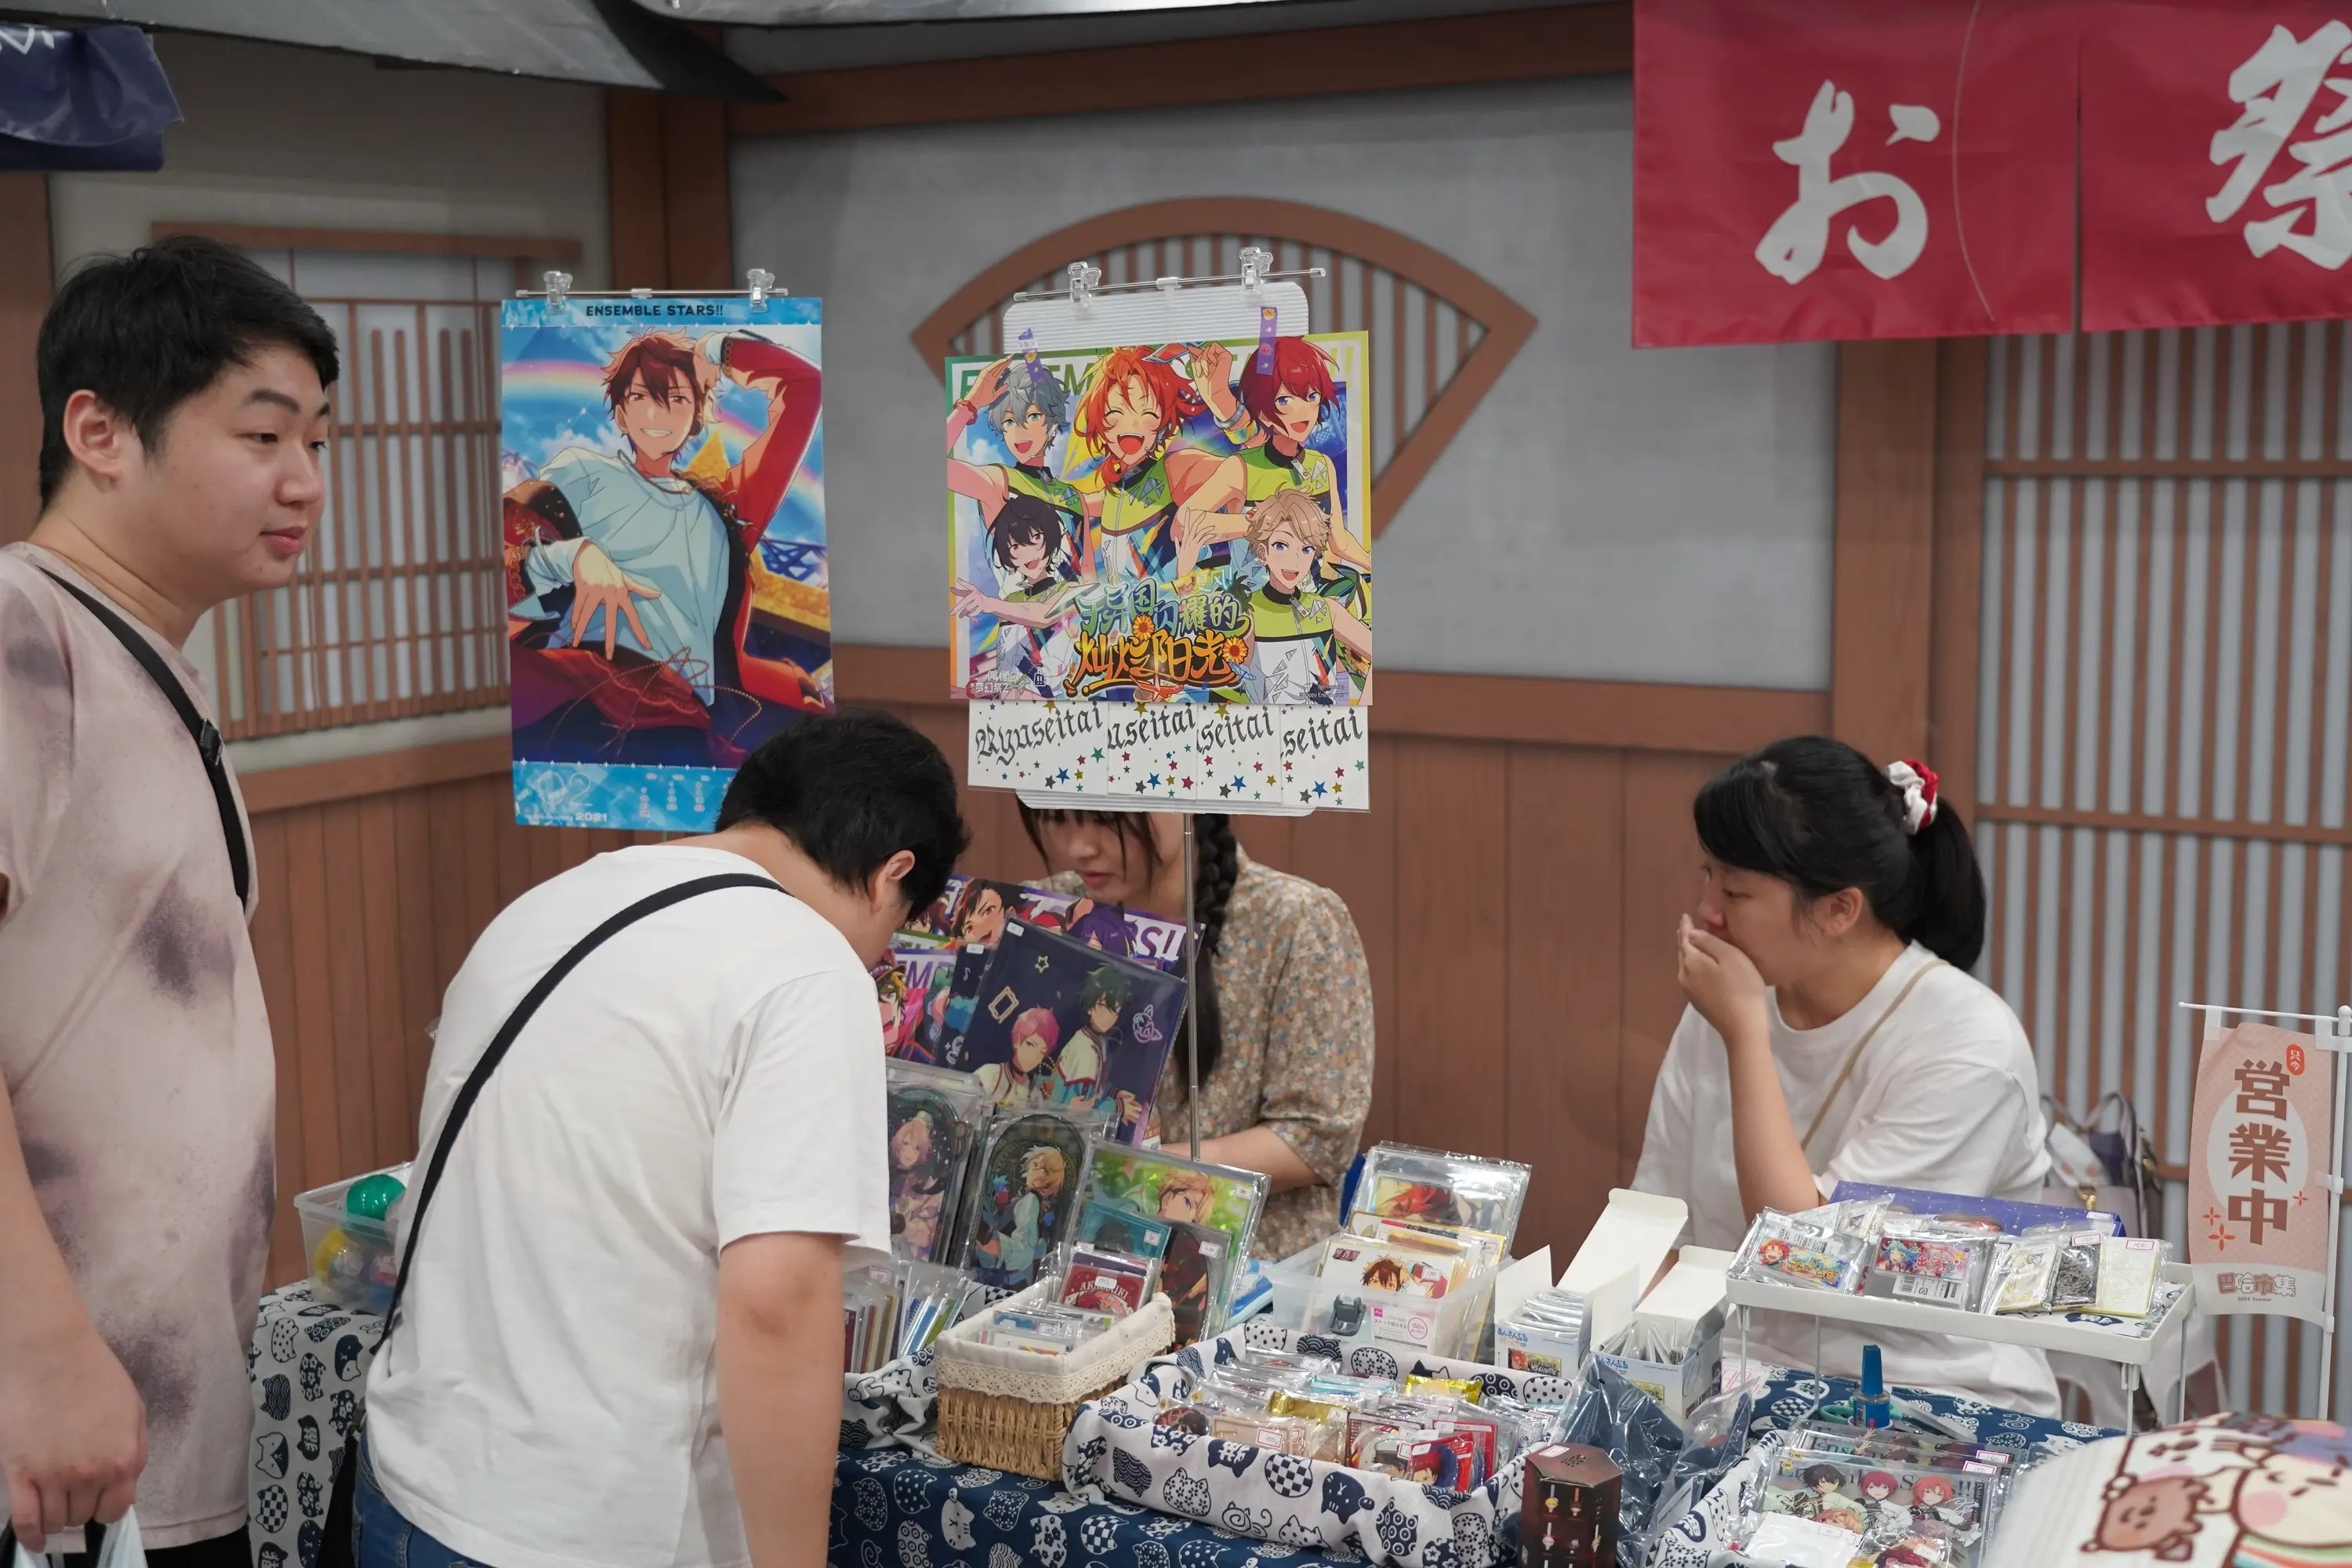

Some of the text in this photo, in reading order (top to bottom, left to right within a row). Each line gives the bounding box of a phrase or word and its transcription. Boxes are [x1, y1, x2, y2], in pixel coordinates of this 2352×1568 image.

[586, 304, 724, 317] ENSEMBLE STARS!!
[975, 700, 1104, 766] Ryuseitai
[1280, 707, 1363, 759] seitai
[575, 811, 608, 822] 2021
[2227, 1058, 2291, 1246] 営業中
